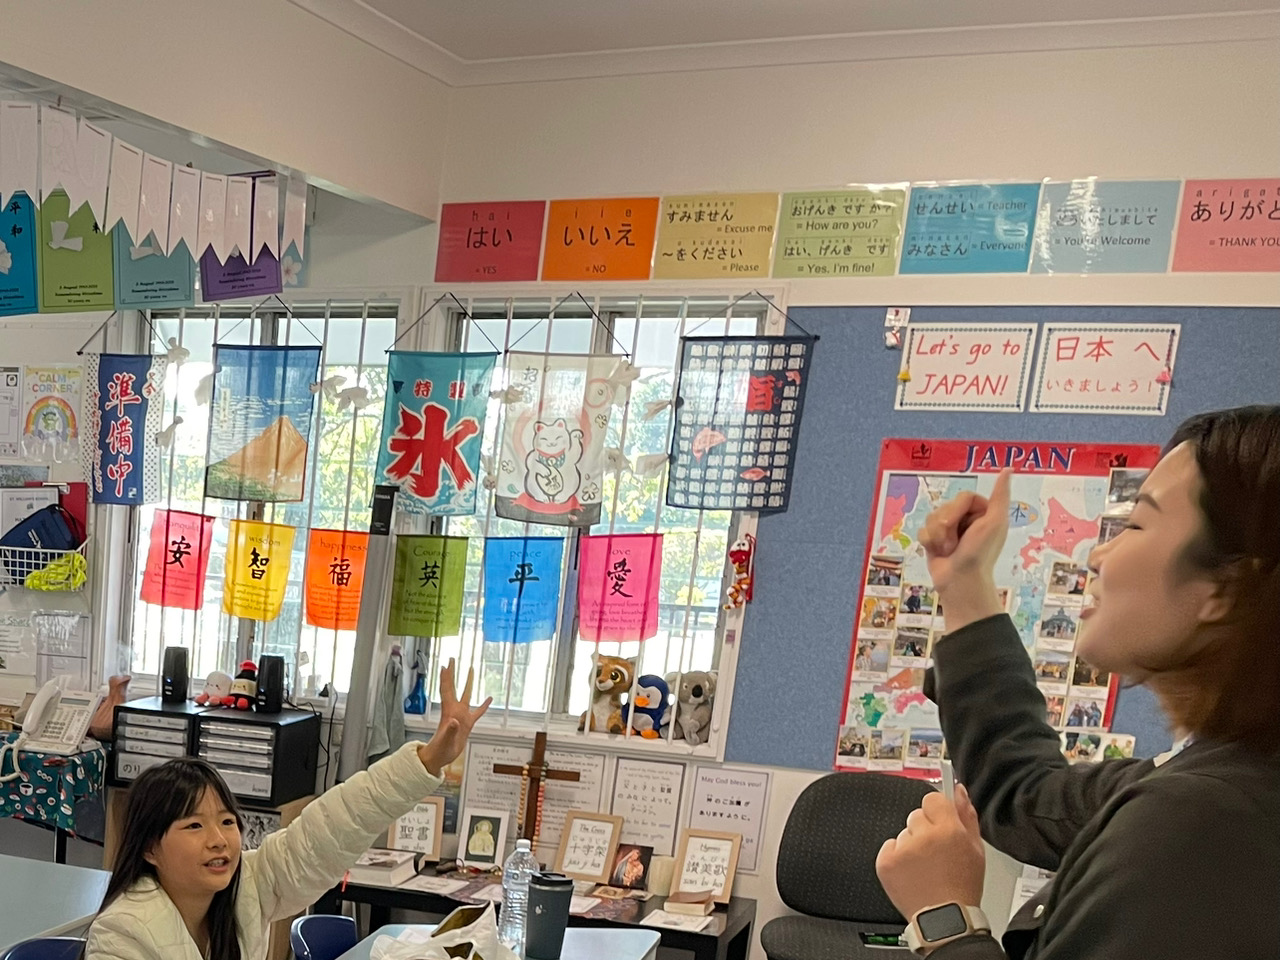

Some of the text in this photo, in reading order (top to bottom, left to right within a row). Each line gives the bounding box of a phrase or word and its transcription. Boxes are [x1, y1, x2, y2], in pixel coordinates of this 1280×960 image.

[792, 204, 865, 216] おげんき です
[914, 201, 974, 214] せんせい
[987, 200, 1028, 211] Teacher
[667, 209, 734, 223] すみません
[724, 224, 773, 233] Excuse me
[806, 219, 878, 231] How are you?
[467, 227, 512, 248] はい
[563, 223, 636, 247] いいえ
[1101, 235, 1151, 246] Welcome
[1218, 237, 1257, 247] THANK
[819, 244, 853, 256] げんき
[867, 244, 888, 255] です
[907, 244, 968, 256] みなさん
[980, 240, 1028, 251] Everyone
[482, 265, 497, 275] YES
[592, 264, 607, 273] NO
[729, 262, 759, 272] Please
[833, 262, 875, 273] I'm fine!
[915, 334, 1020, 365] Let's go to
[1056, 335, 1160, 362] 日本 へ
[38, 374, 67, 384] CALM
[916, 374, 1009, 396] JAPAN!
[1046, 378, 1153, 393] いきましょう！
[32, 384, 73, 393] CORNER
[105, 372, 142, 498] 準備中
[384, 402, 480, 500] 氷
[959, 444, 1075, 472] JAPAN
[249, 534, 281, 547] wisdom
[320, 538, 367, 554] happiness
[166, 536, 192, 568] 安
[509, 549, 541, 561] peace
[248, 547, 270, 580] 智
[328, 557, 352, 587] 福
[418, 560, 441, 589] 英
[606, 557, 633, 598] 愛
[508, 562, 540, 598] 平
[122, 764, 141, 775] のり
[701, 775, 762, 789] May God bless you!
[399, 825, 430, 841] 聖書
[570, 843, 608, 858] 十字架
